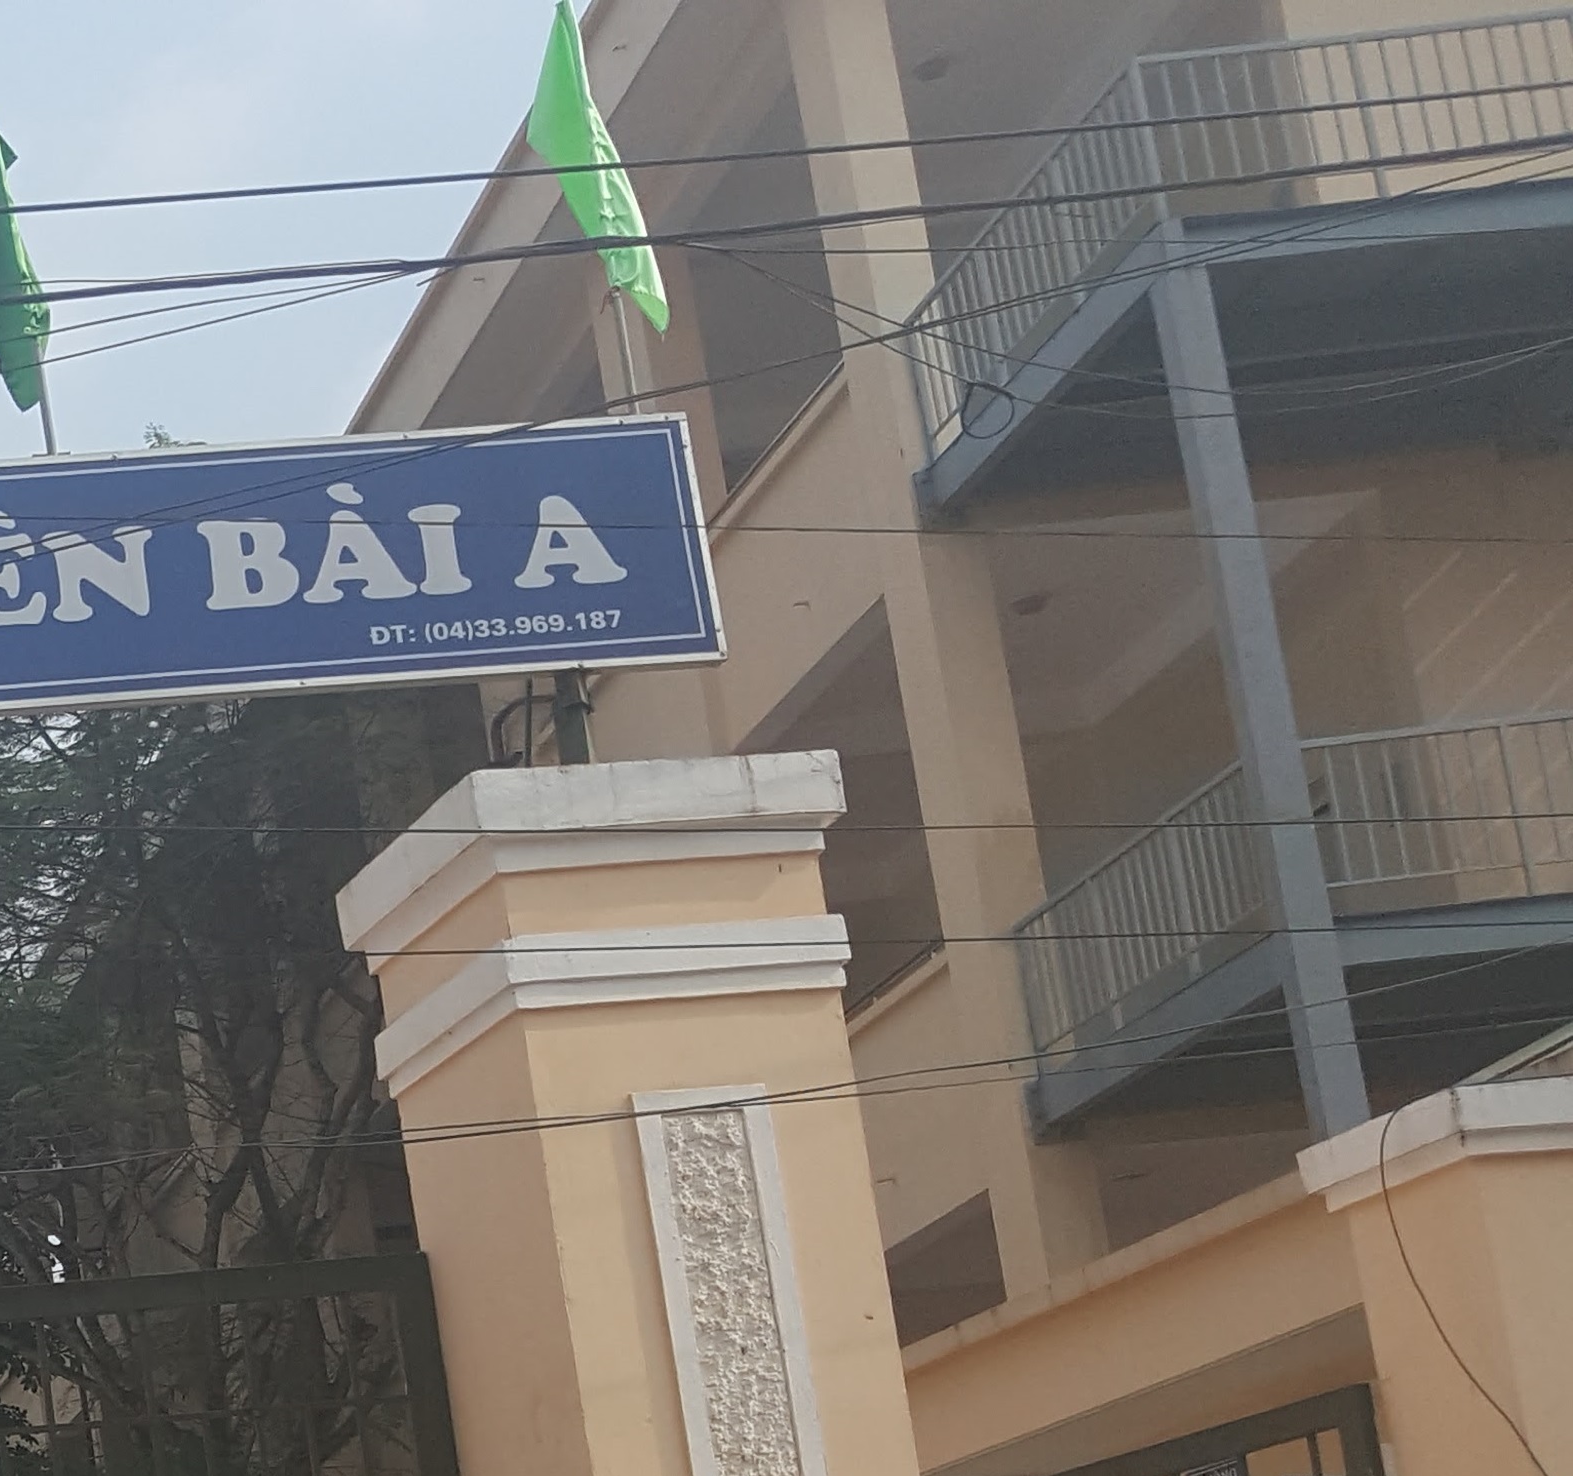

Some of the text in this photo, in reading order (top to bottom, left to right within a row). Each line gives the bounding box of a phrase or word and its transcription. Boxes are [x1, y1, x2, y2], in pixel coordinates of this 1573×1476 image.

[196, 482, 473, 612] BÀI
[514, 495, 628, 590] A
[369, 609, 622, 645] ĐT: (04)33.969.187
